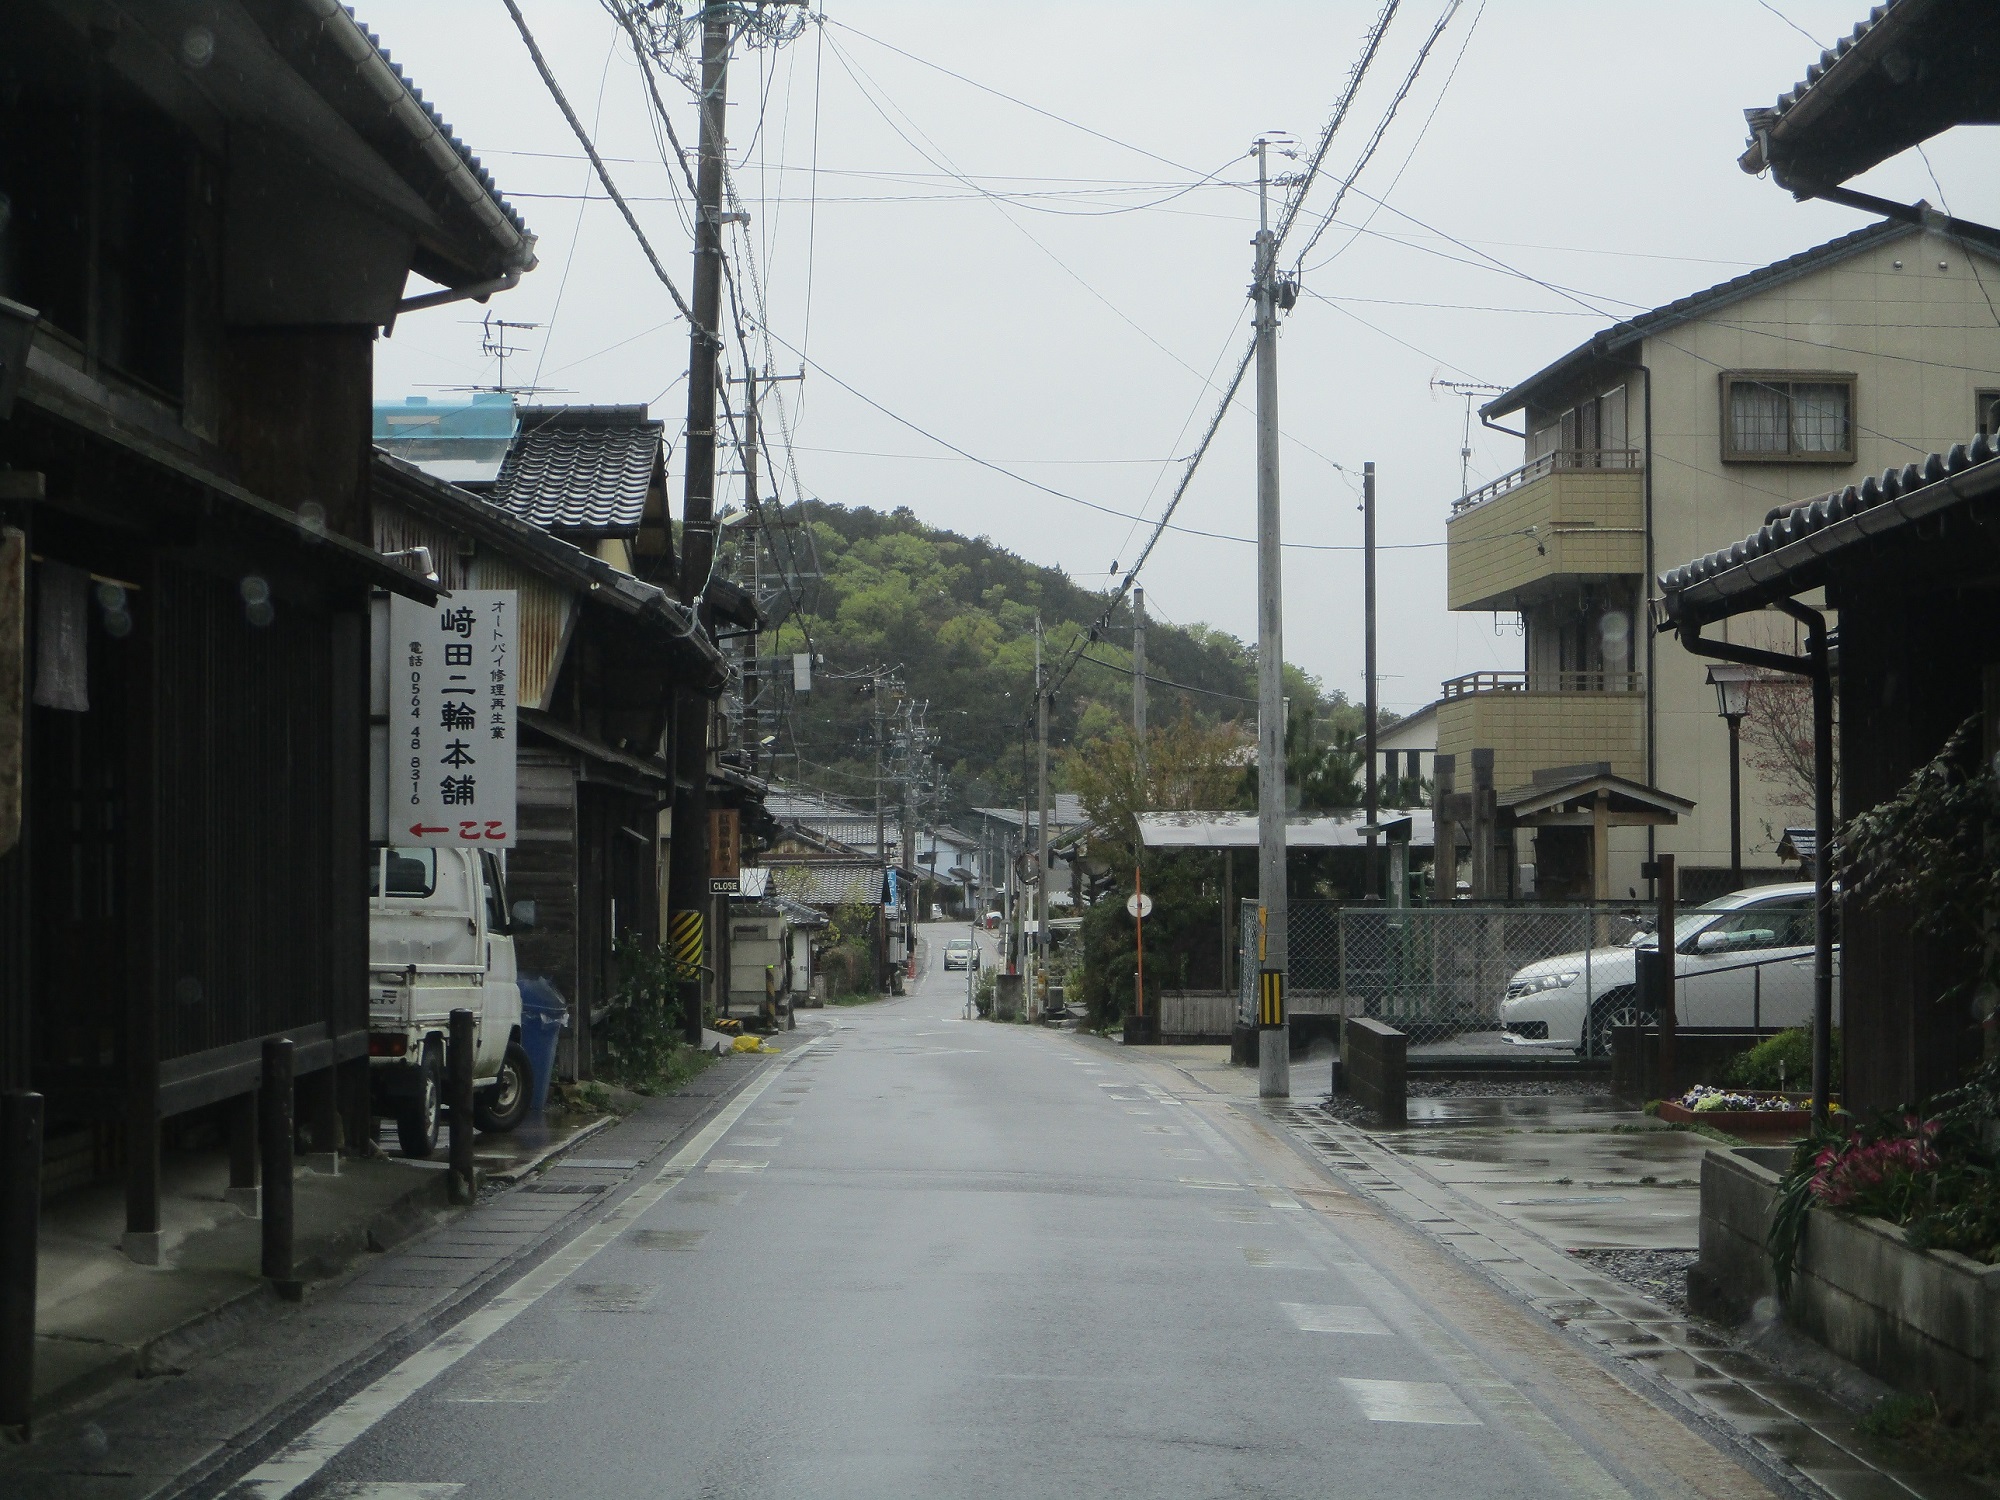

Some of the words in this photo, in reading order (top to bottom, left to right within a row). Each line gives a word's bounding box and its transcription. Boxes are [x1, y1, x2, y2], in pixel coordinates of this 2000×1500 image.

[408, 641, 423, 667] 電話
[490, 601, 506, 740] オートバイ修理再生業
[410, 671, 421, 719] 0564
[410, 726, 421, 750] 48
[410, 757, 421, 805] 8316
[459, 820, 507, 840] ここ
[713, 881, 737, 891] CLOSE
